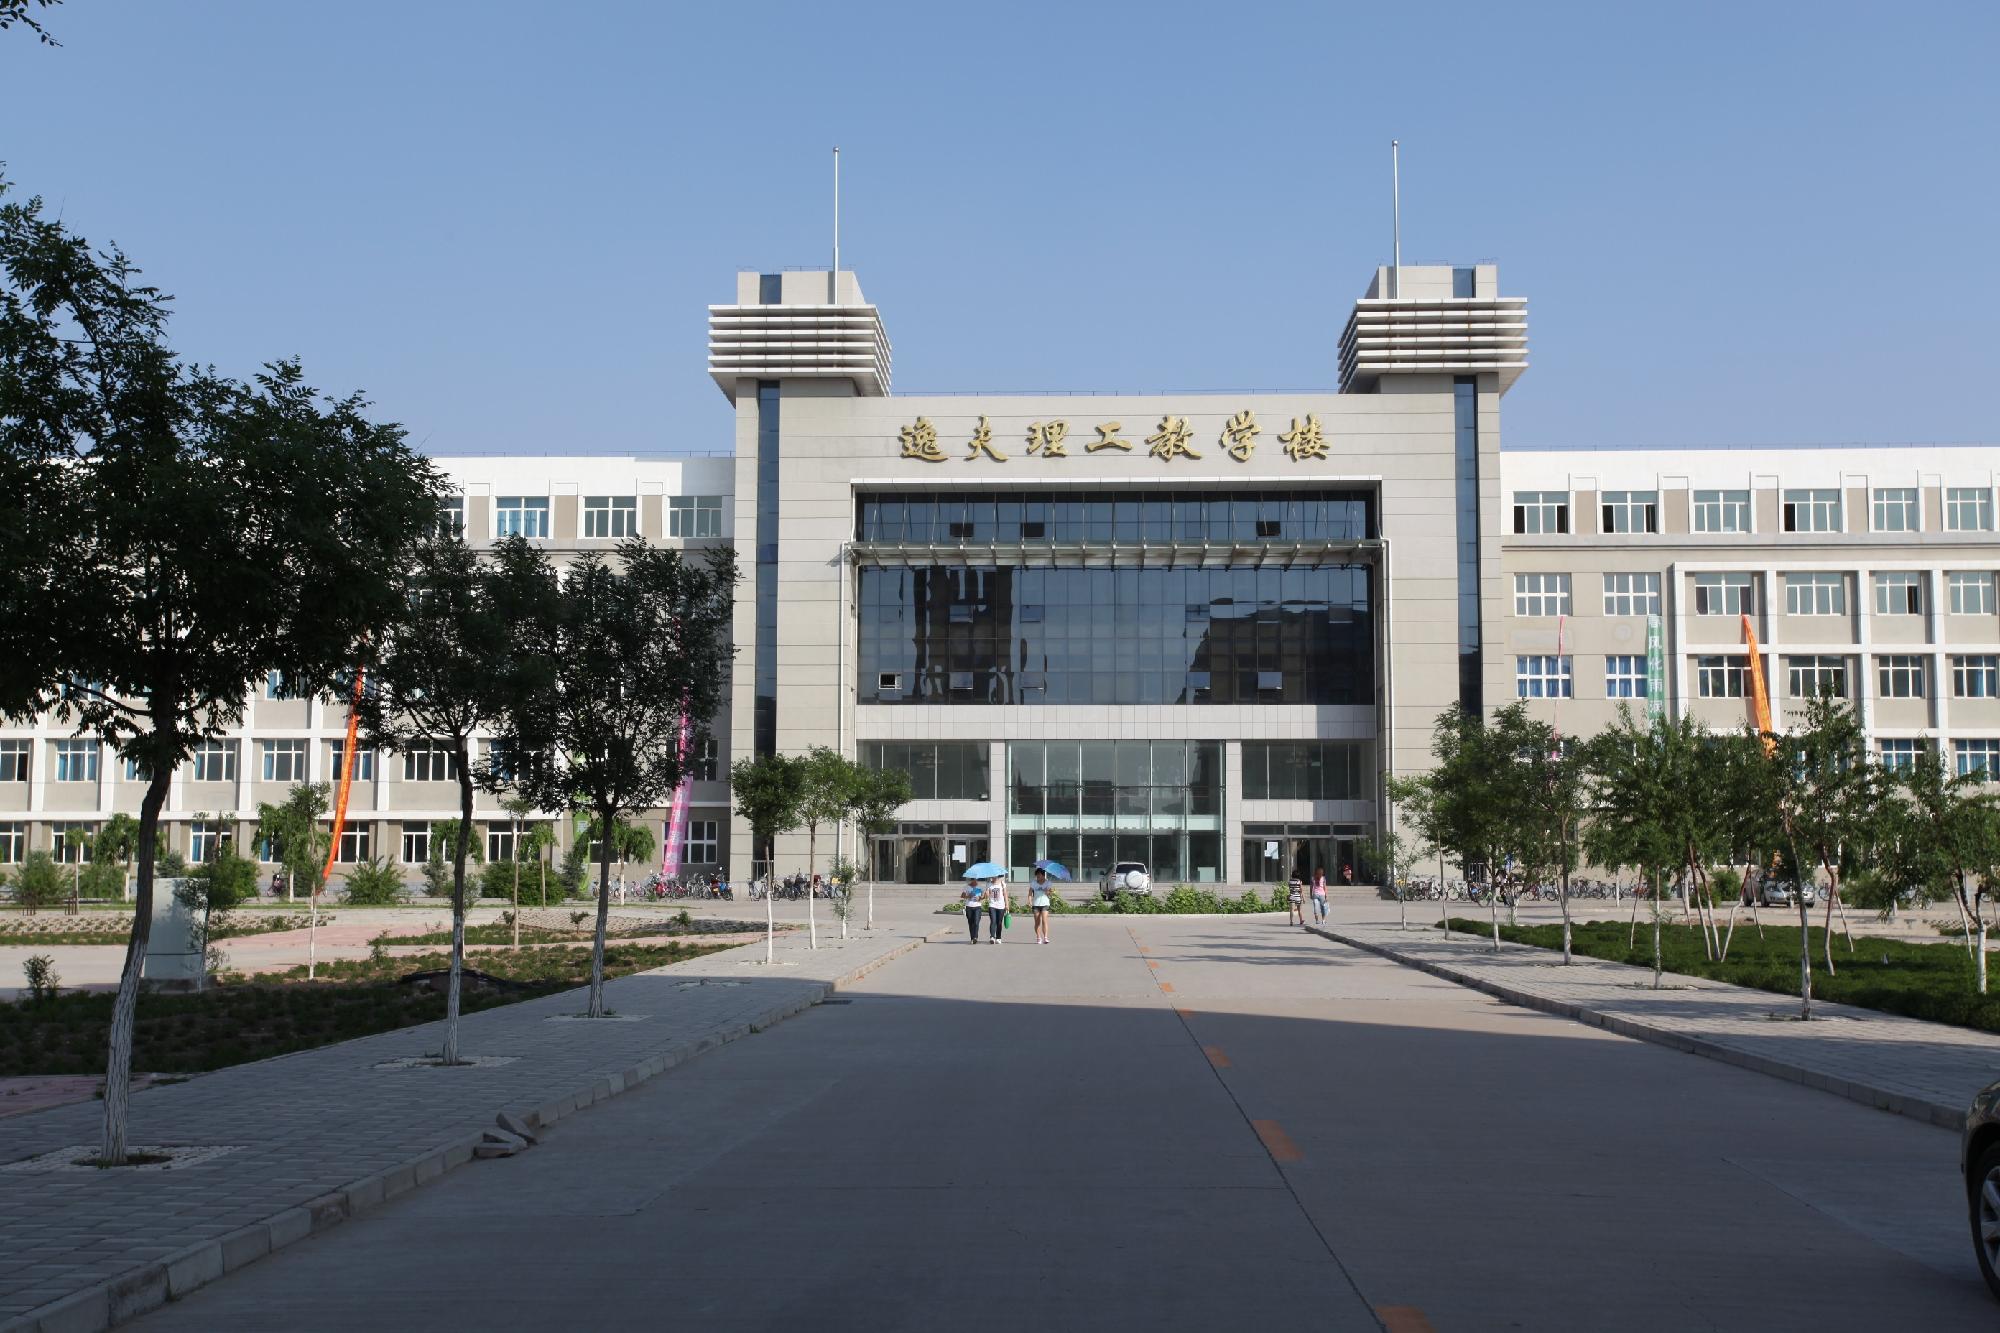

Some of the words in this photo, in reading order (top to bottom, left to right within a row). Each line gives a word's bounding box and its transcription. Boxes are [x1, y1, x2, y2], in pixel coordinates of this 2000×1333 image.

[899, 410, 1331, 463] 逸夫理工教学楼
